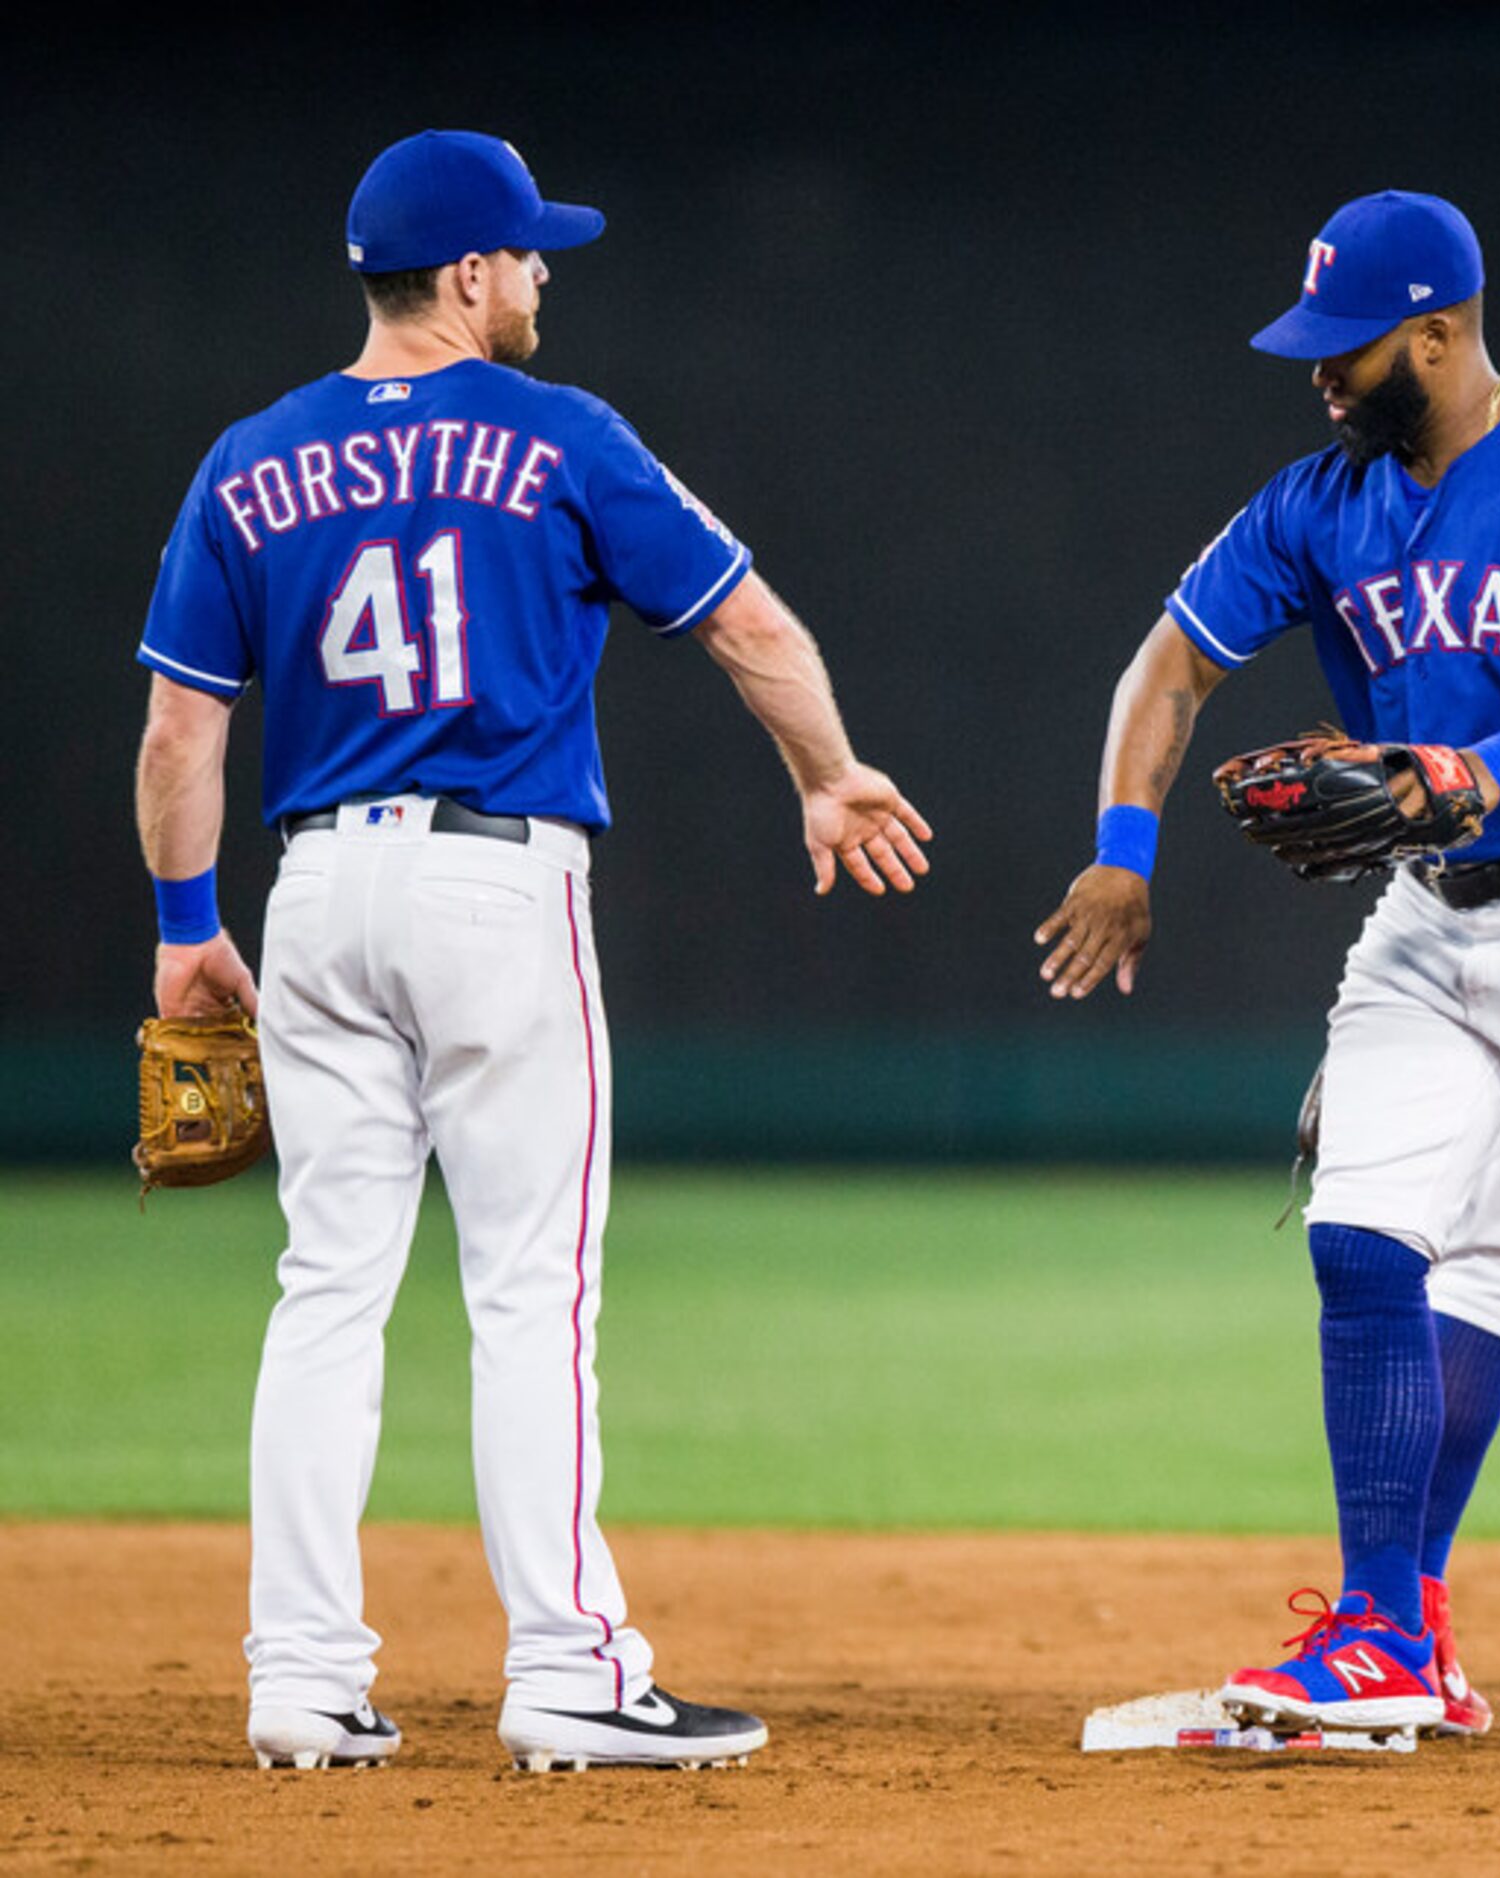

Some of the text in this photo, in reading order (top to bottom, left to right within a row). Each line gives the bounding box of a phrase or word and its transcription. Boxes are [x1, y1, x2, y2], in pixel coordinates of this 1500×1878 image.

[1303, 237, 1337, 296] T
[215, 418, 563, 555] FORSYTHE
[317, 526, 475, 719] 41
[1332, 1648, 1387, 1694] N
